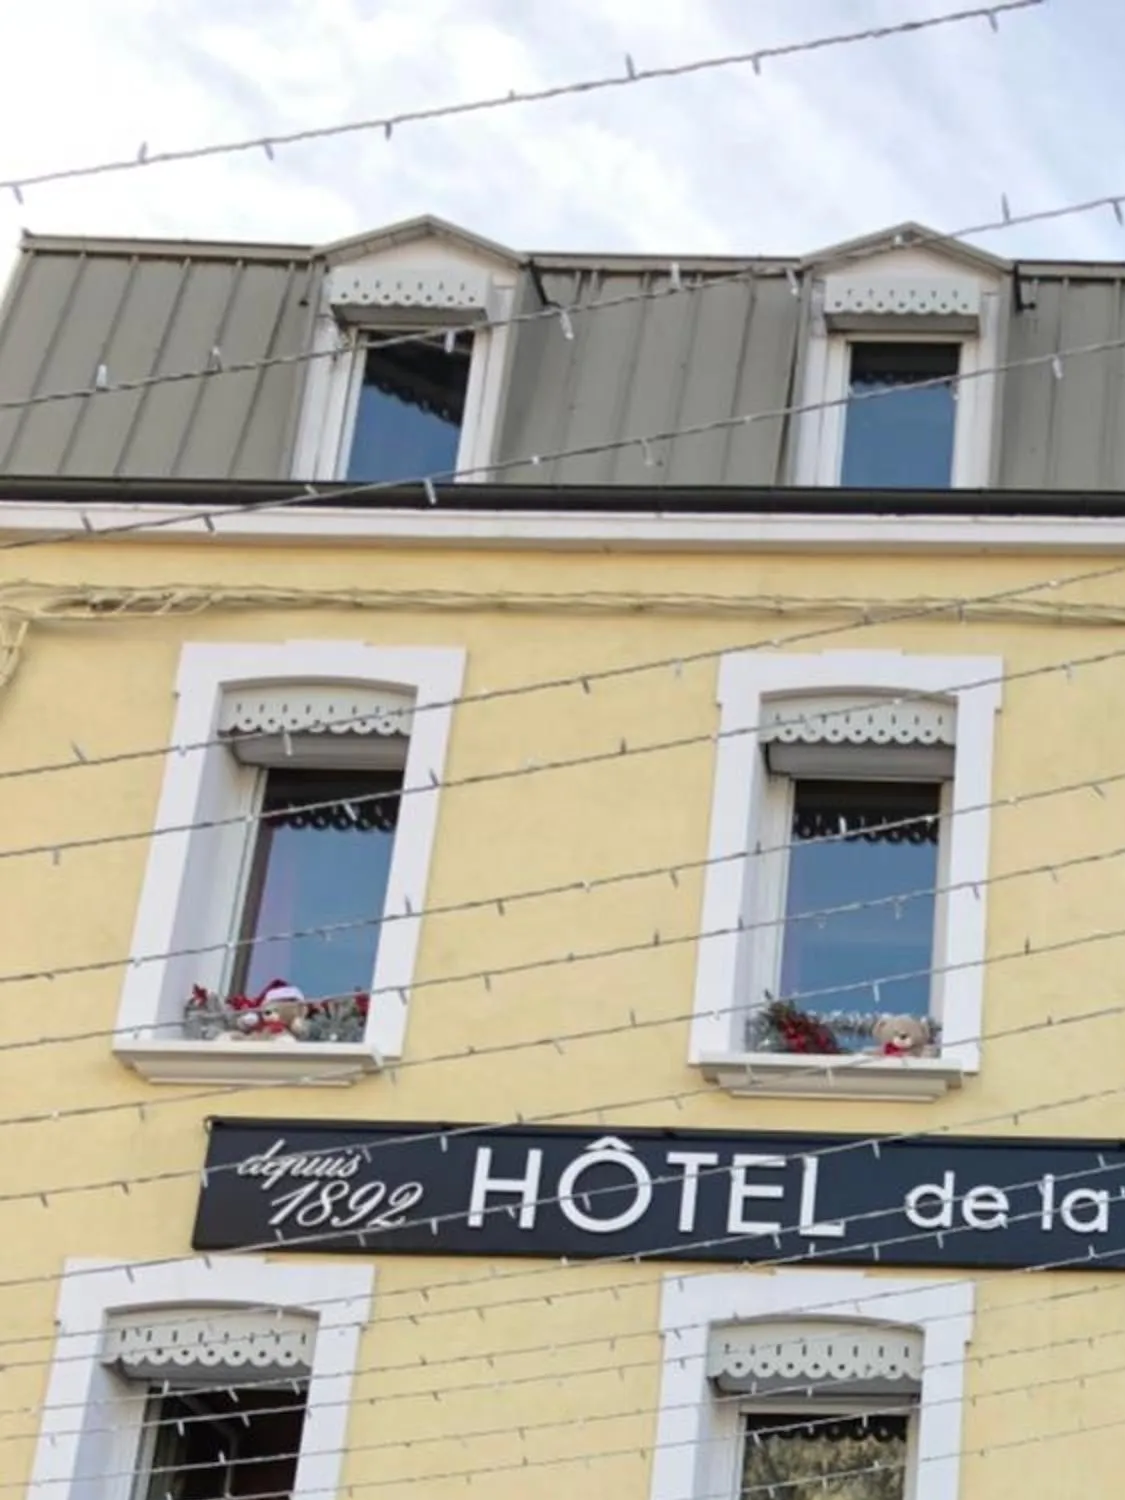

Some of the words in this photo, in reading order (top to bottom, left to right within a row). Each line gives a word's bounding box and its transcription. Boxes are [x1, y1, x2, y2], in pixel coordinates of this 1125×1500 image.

[236, 1138, 362, 1190] depuis
[467, 1135, 845, 1237] HÔTEL
[904, 1171, 1010, 1230] de
[1041, 1174, 1111, 1233] la
[268, 1179, 424, 1228] 1892
